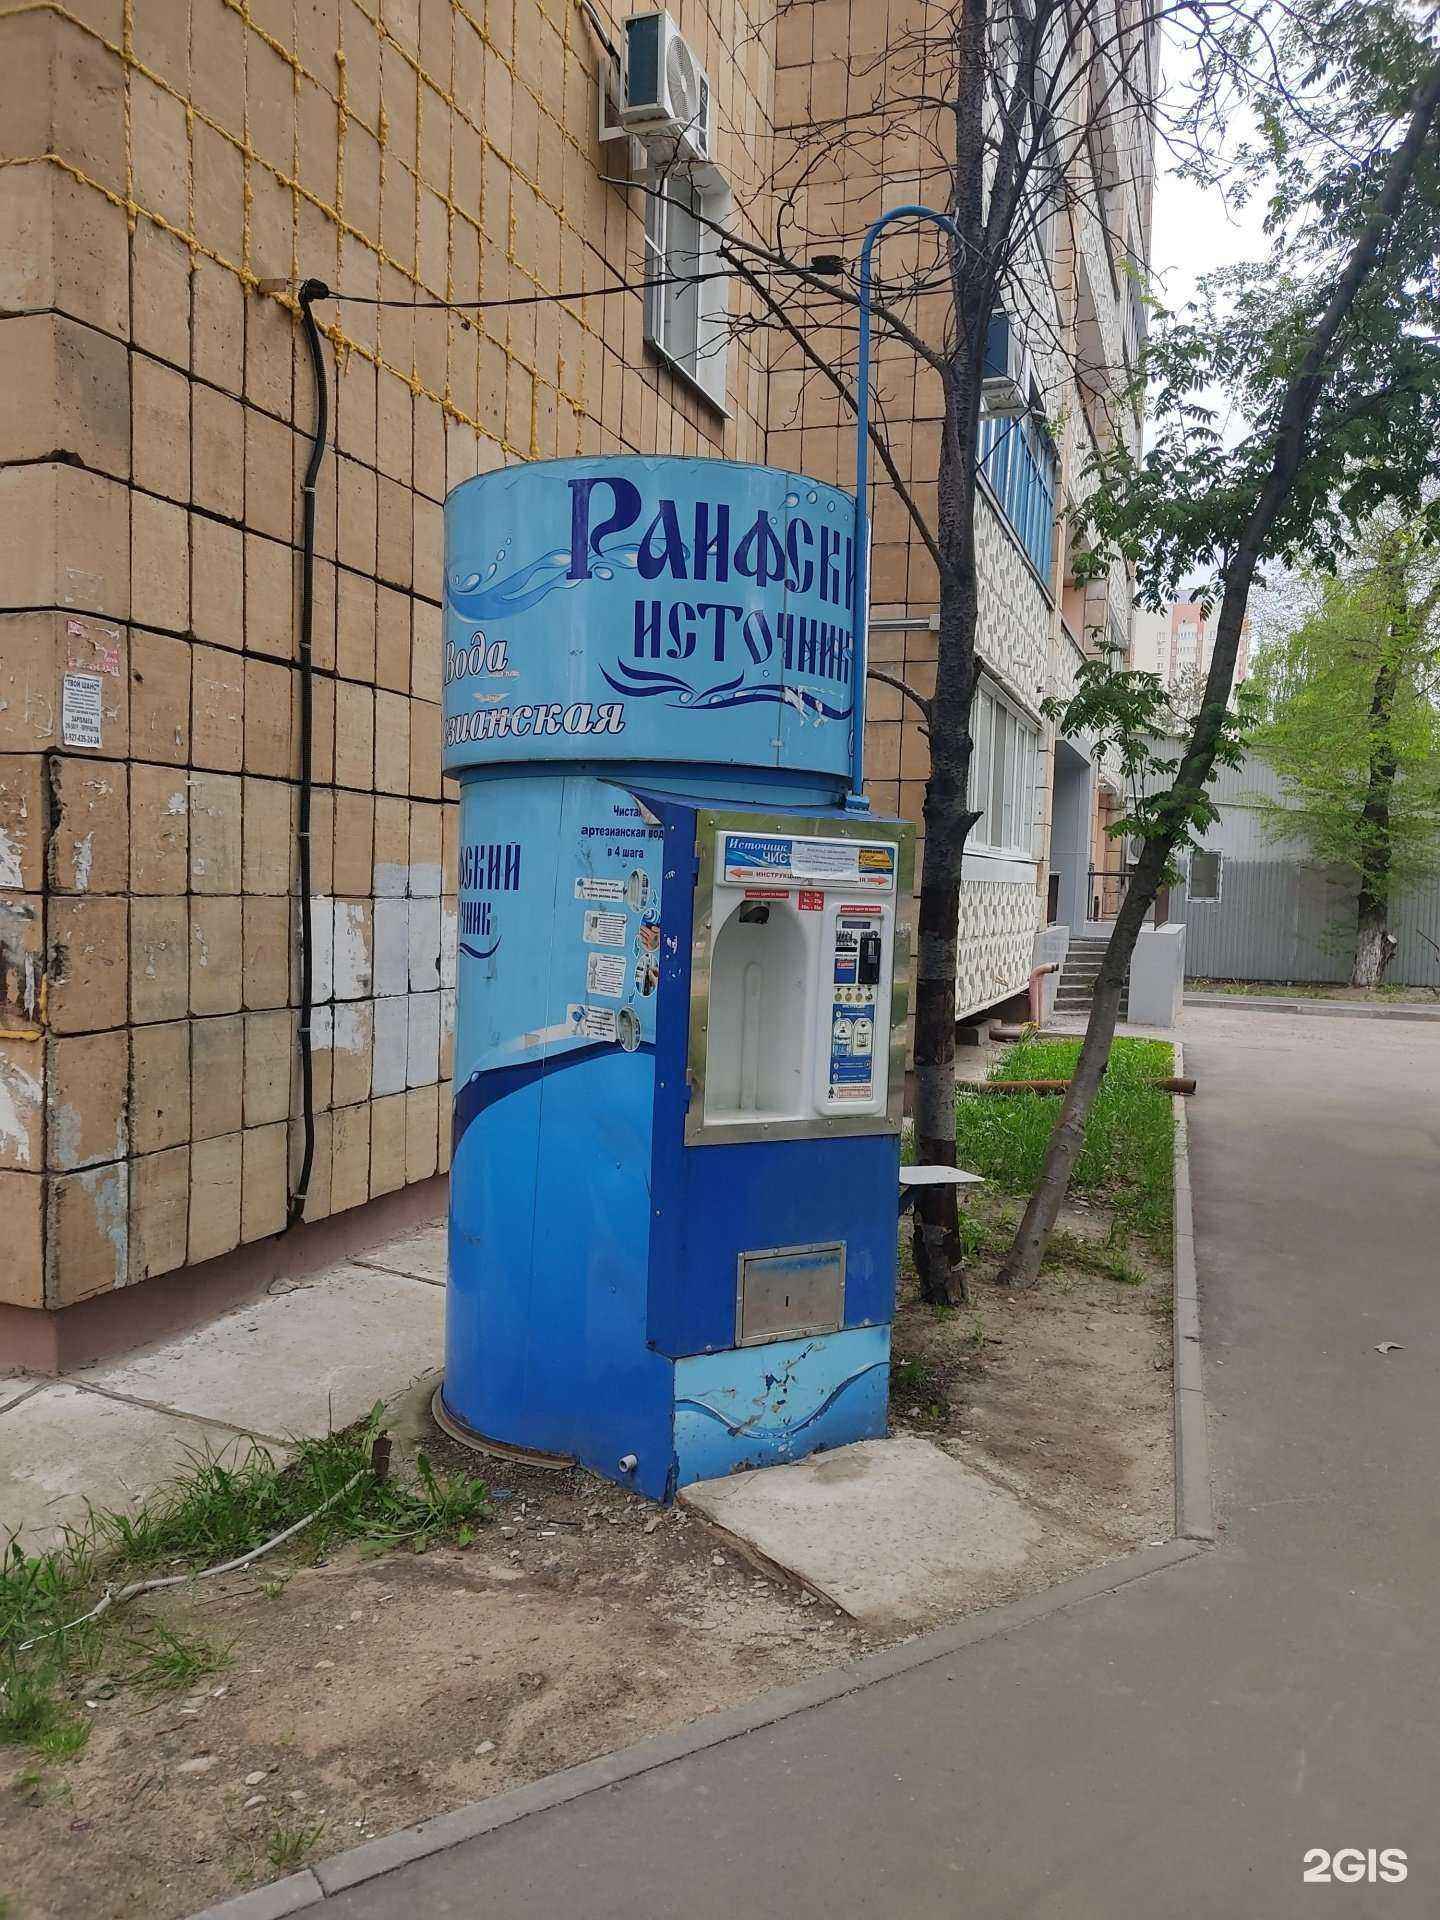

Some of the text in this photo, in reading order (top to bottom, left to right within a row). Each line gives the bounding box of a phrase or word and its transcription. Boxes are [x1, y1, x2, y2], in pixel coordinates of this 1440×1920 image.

[634, 600, 855, 684] ИСТОЧНИК
[443, 630, 508, 686] Вода
[581, 826, 646, 839] артезианская
[614, 845, 621, 857] 4
[622, 848, 644, 859] шага
[728, 838, 788, 853] Источник
